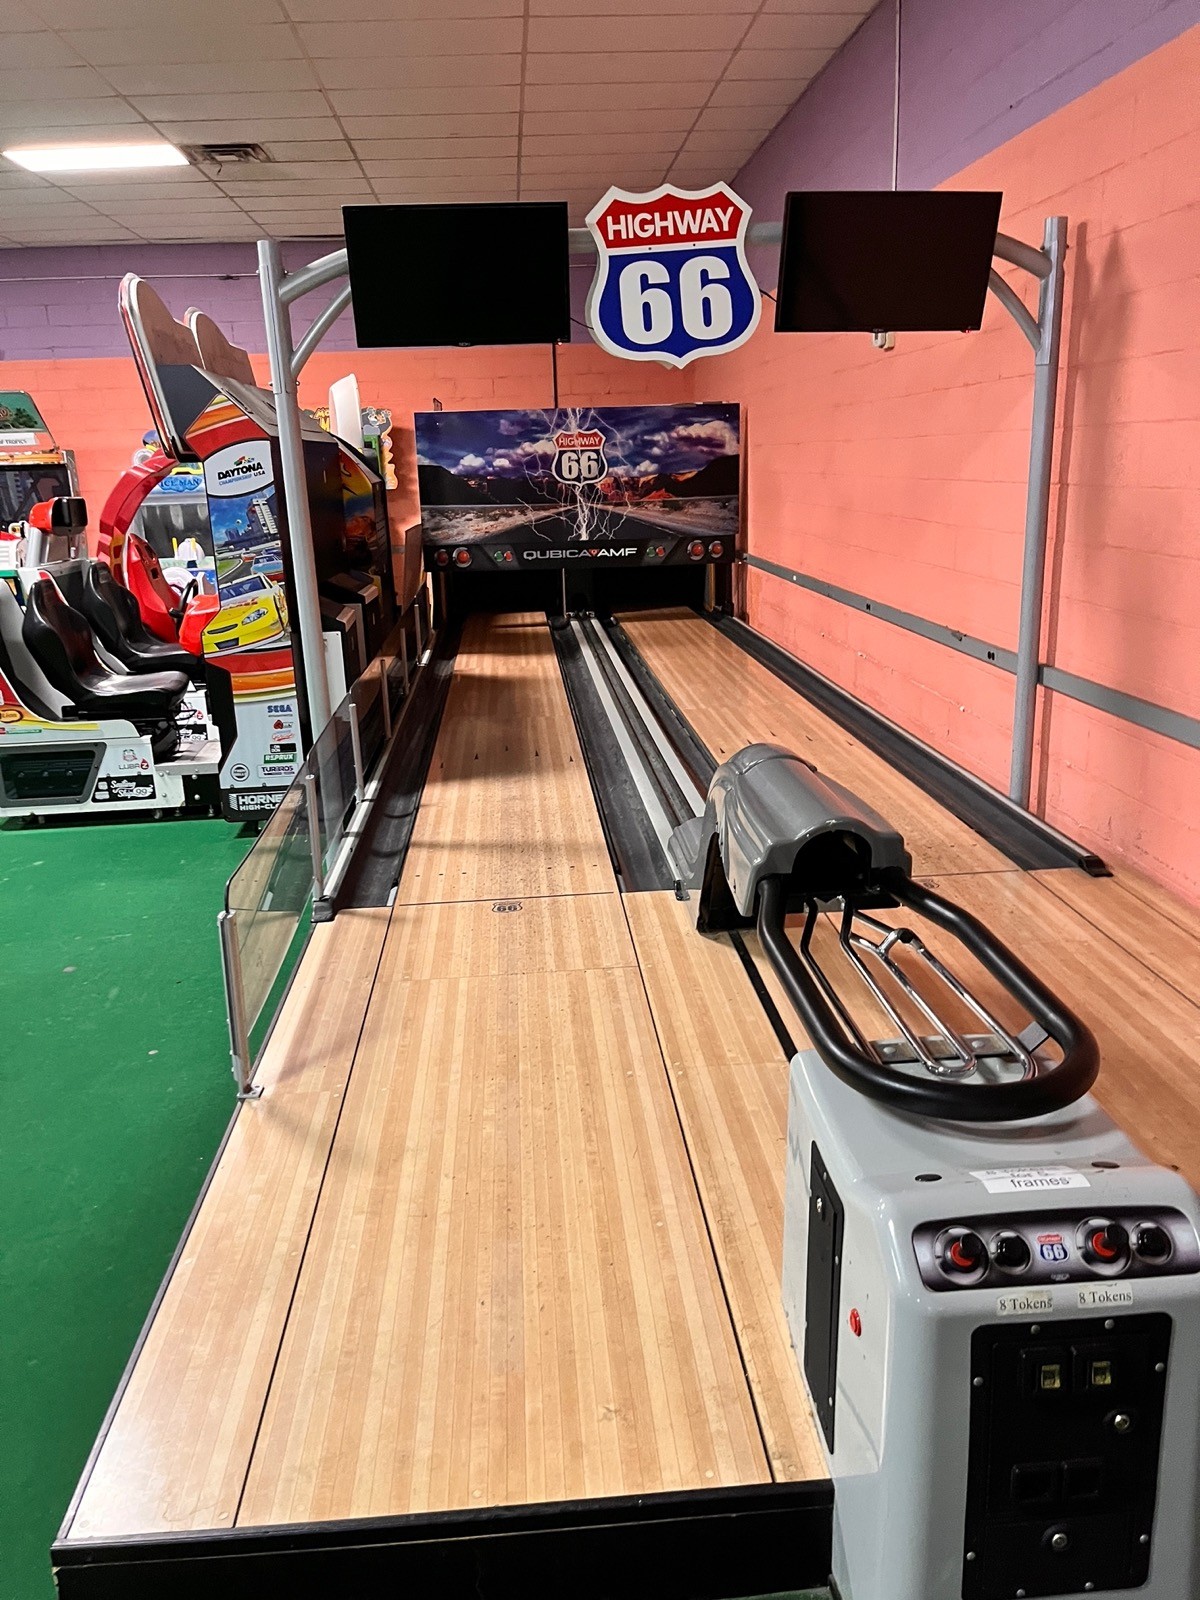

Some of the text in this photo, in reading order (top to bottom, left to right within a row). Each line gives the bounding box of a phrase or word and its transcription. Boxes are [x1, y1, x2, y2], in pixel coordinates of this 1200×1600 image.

[606, 206, 734, 241] HIGHWAY
[619, 255, 733, 345] 66
[558, 436, 600, 446] HIGHWAY
[217, 462, 264, 481] DAYTONA
[561, 451, 599, 479] 66
[180, 478, 199, 486] MAN
[523, 547, 638, 560] QUBICA AMF
[267, 704, 293, 713] SEGA
[1042, 1244, 1065, 1260] 66
[999, 1297, 1053, 1311] 8 Tokens
[1079, 1290, 1132, 1304] 8 Tokens
